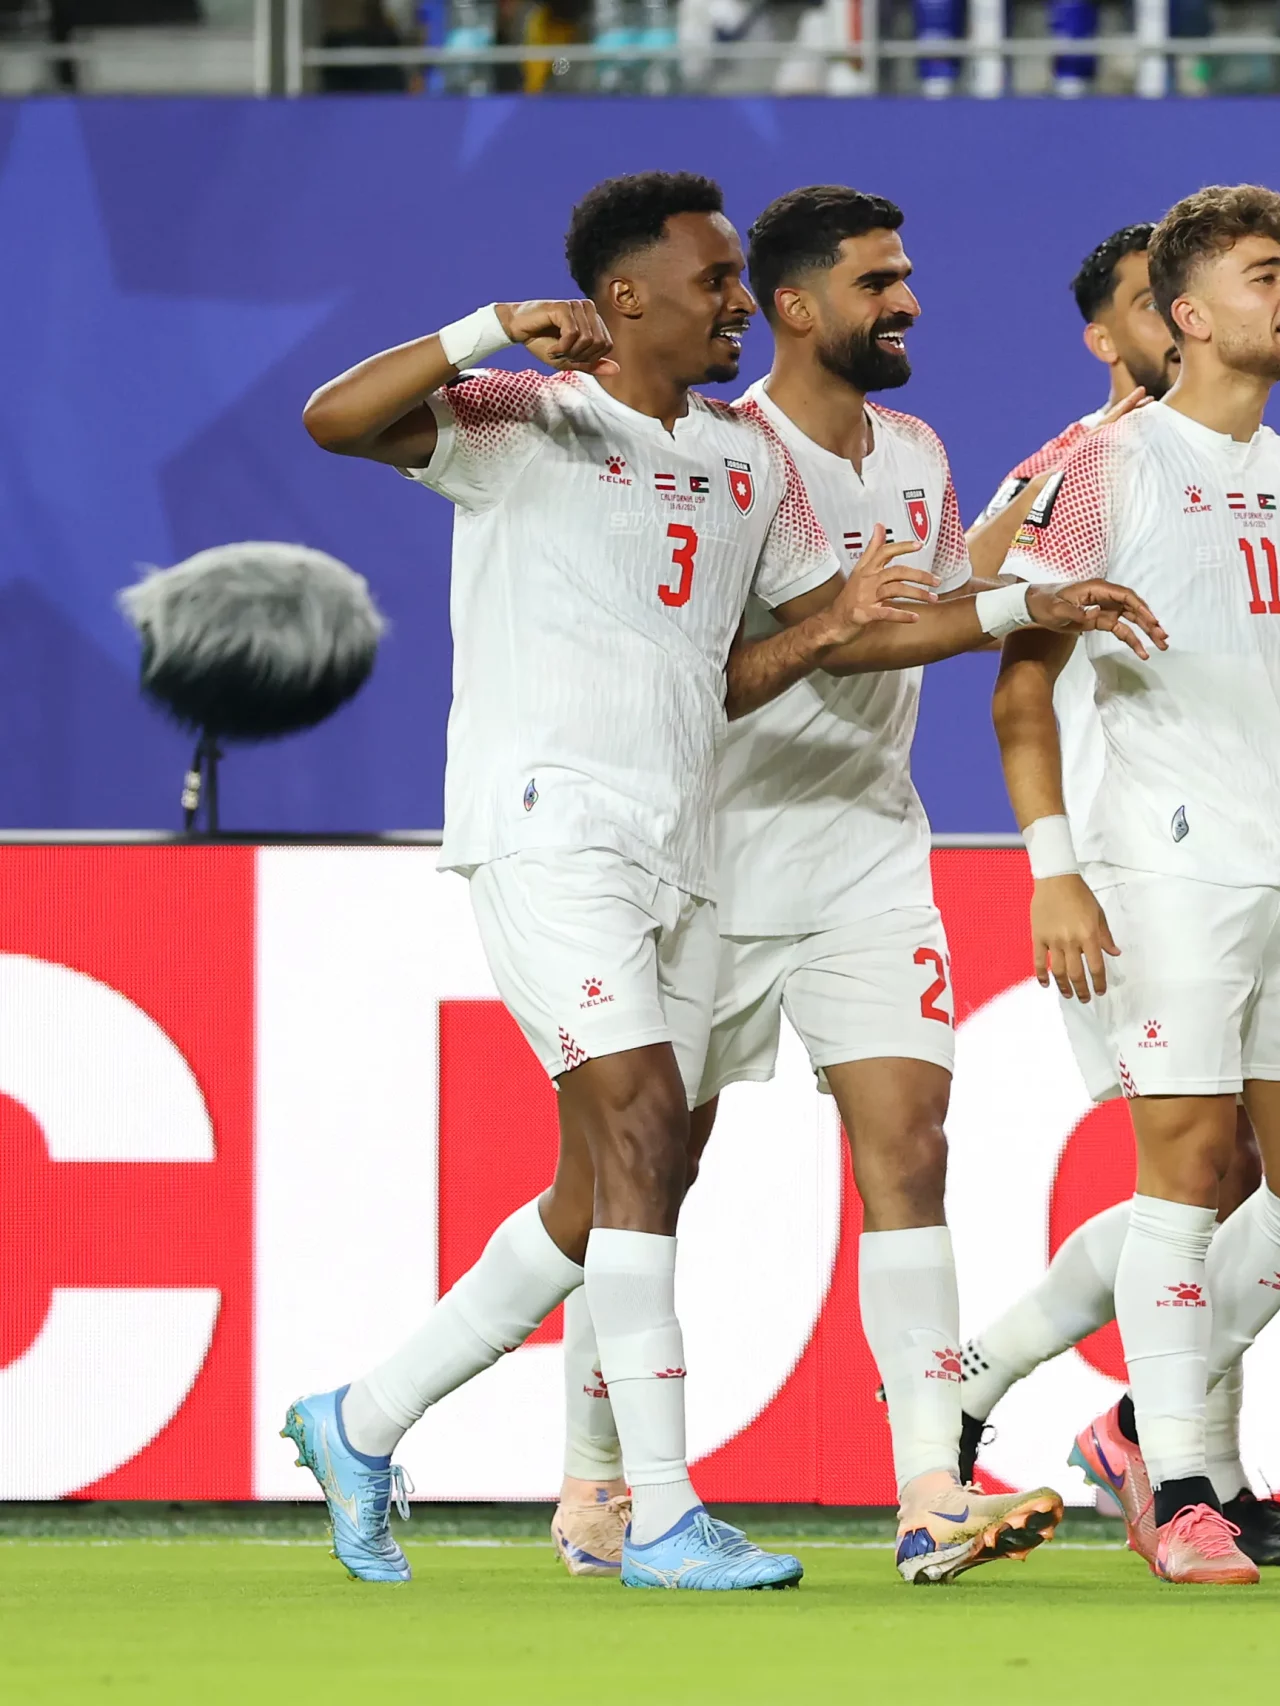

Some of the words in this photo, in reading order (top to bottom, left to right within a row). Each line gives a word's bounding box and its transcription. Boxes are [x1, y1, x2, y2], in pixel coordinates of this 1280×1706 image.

[727, 460, 748, 471] JORDAN
[598, 474, 632, 486] KELME
[1183, 504, 1213, 514] KELME
[658, 523, 698, 608] 3
[913, 947, 955, 1031] 2
[580, 995, 615, 1009] KELME
[1138, 1041, 1168, 1049] KELME
